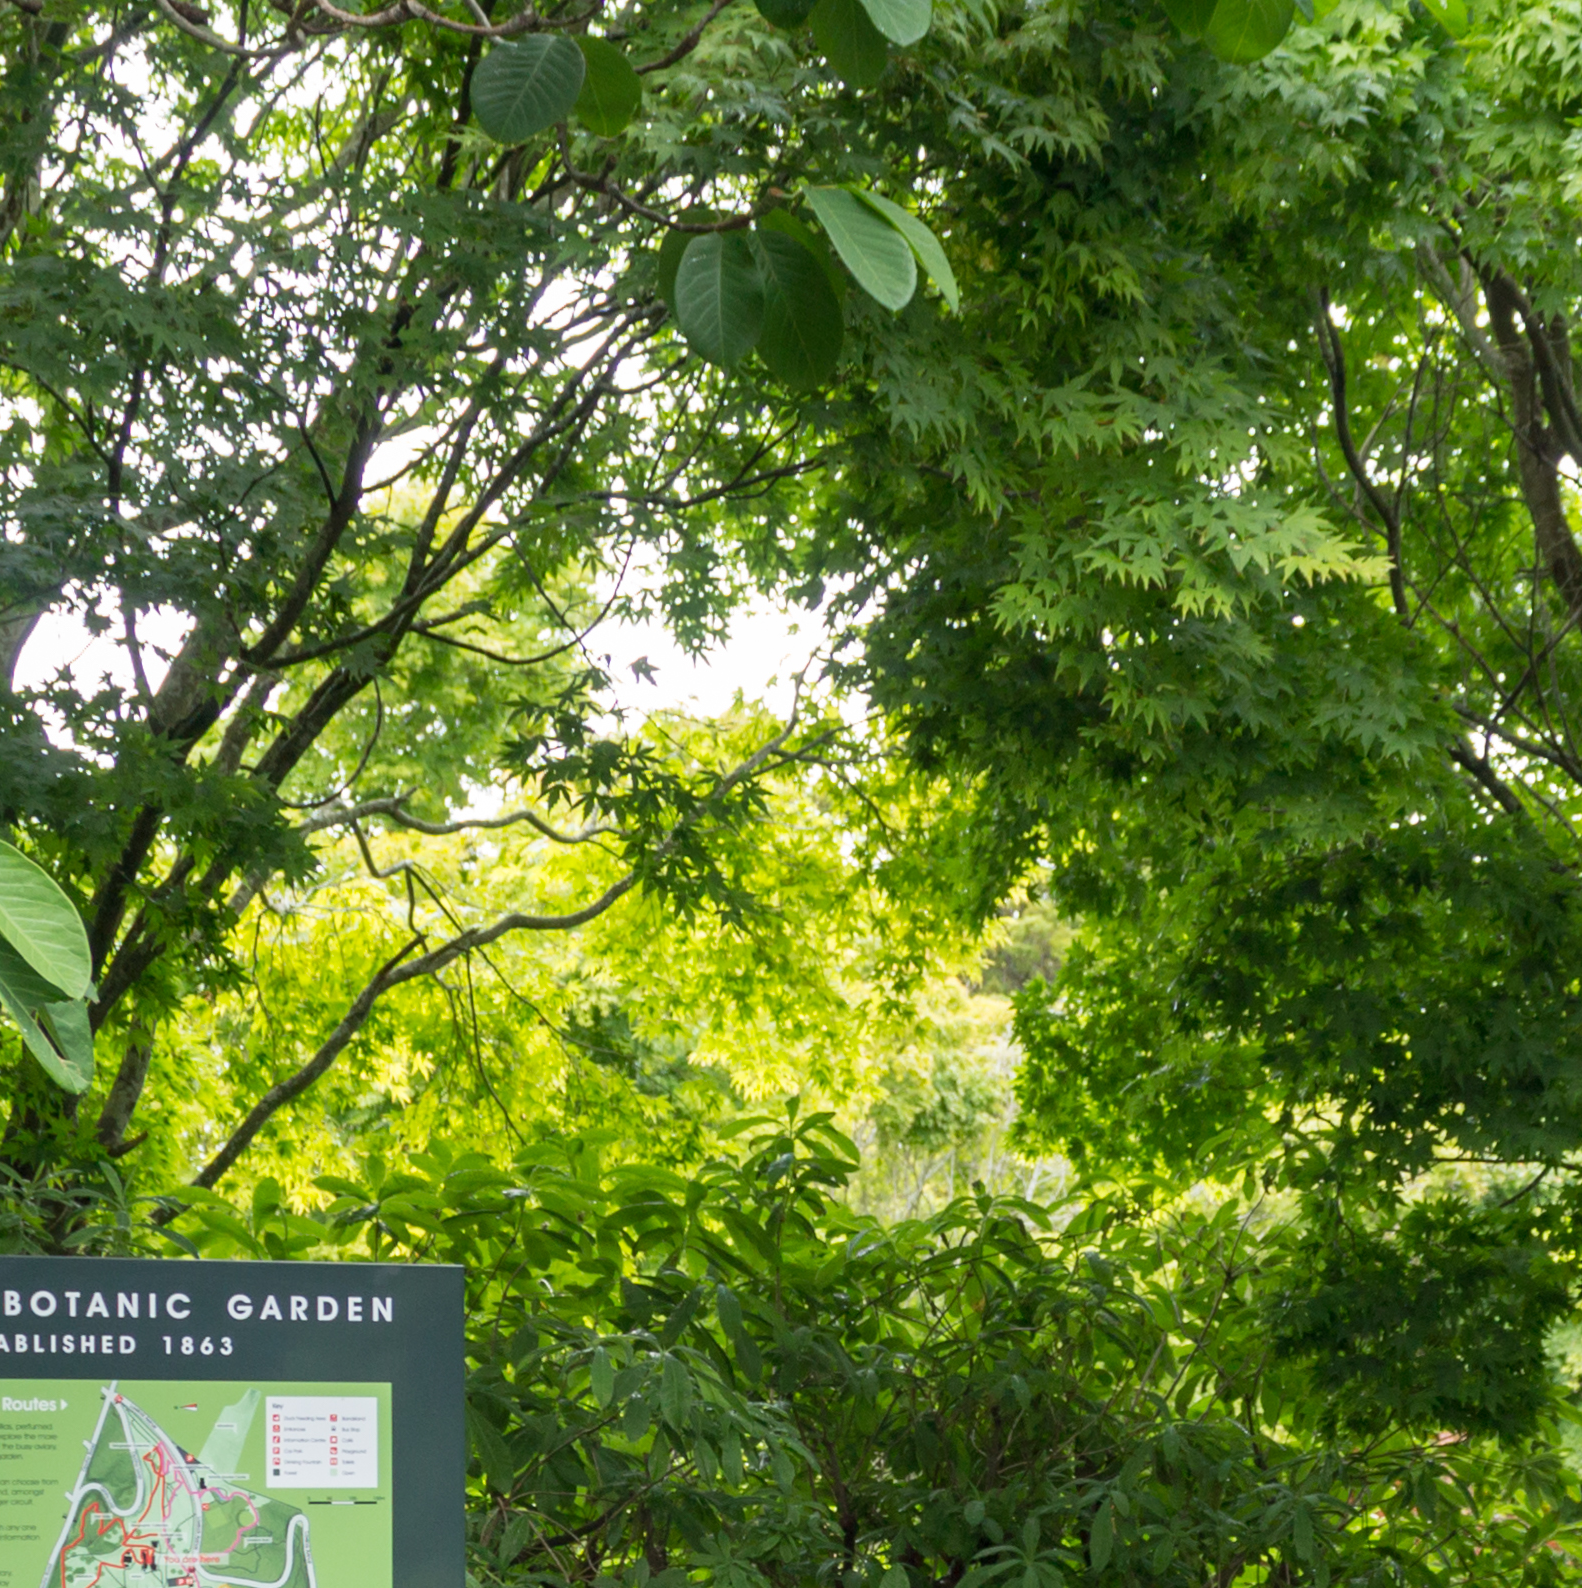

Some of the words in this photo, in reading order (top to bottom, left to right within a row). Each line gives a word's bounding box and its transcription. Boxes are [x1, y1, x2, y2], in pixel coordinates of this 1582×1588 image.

[4, 1290, 190, 1319] BOTANIC
[227, 1294, 392, 1322] GARDEN
[163, 1336, 233, 1356] 1863
[1, 1396, 58, 1412] Routes
[15, 1423, 53, 1431] perfumed
[163, 1556, 180, 1564] You
[199, 1555, 220, 1564] here
